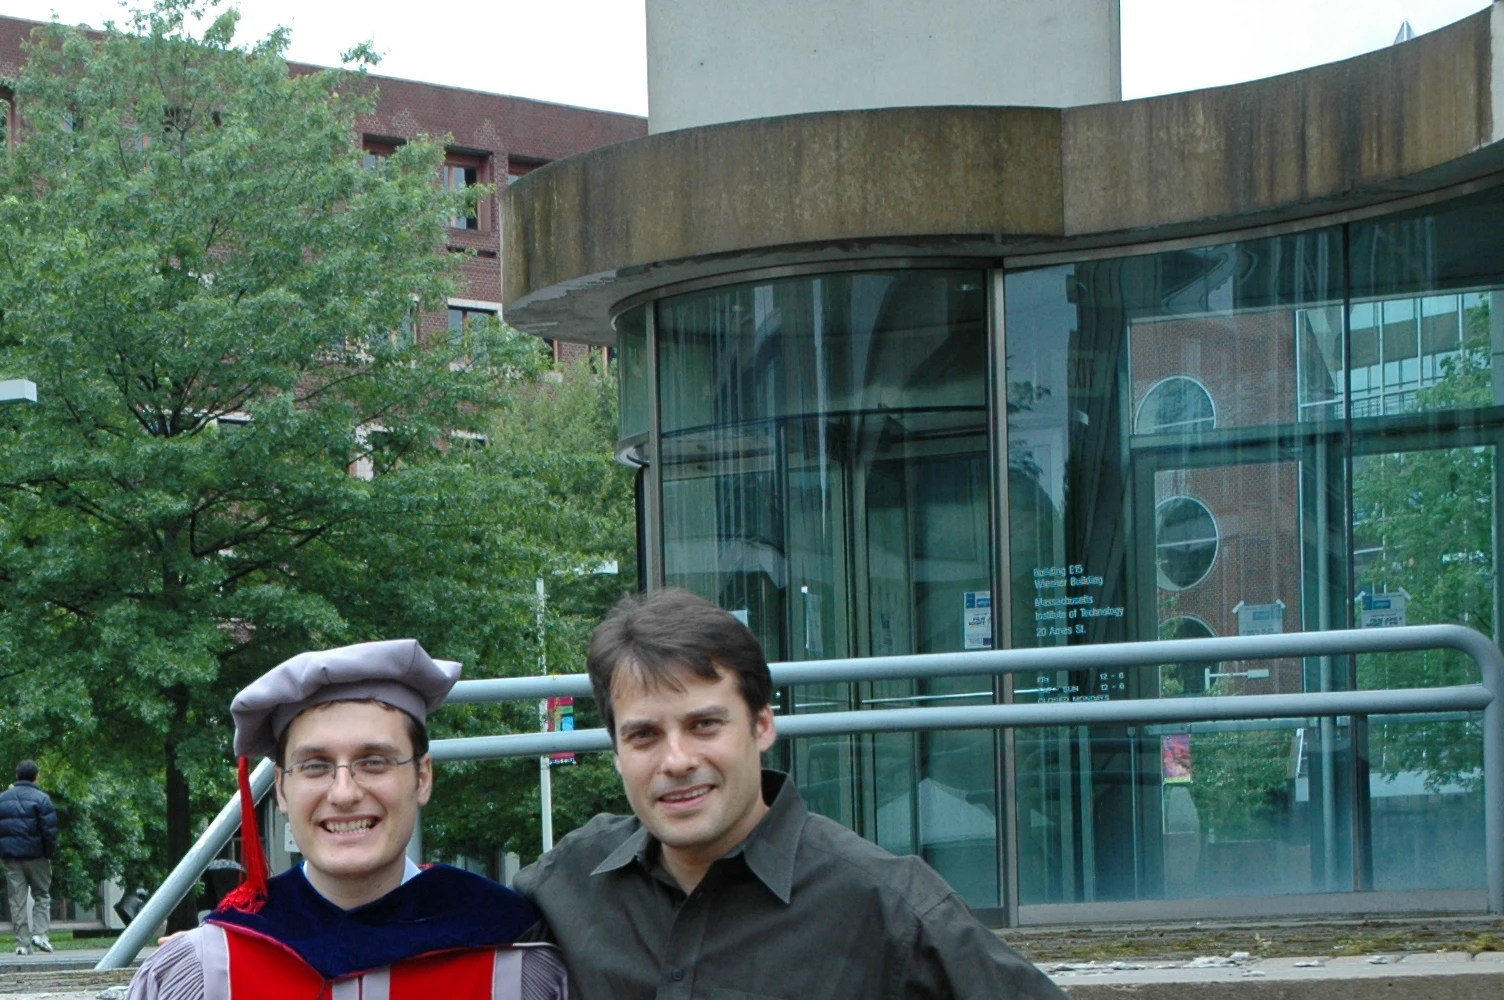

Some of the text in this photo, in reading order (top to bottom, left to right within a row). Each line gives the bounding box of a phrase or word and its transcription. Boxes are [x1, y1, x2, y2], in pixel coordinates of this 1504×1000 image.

[1069, 564, 1083, 575] E15
[1070, 576, 1104, 587] Building
[1035, 596, 1094, 607] Massachusetts
[1036, 606, 1124, 621] Institute of Technology
[1036, 627, 1047, 637] 20
[1049, 626, 1073, 636] Ames
